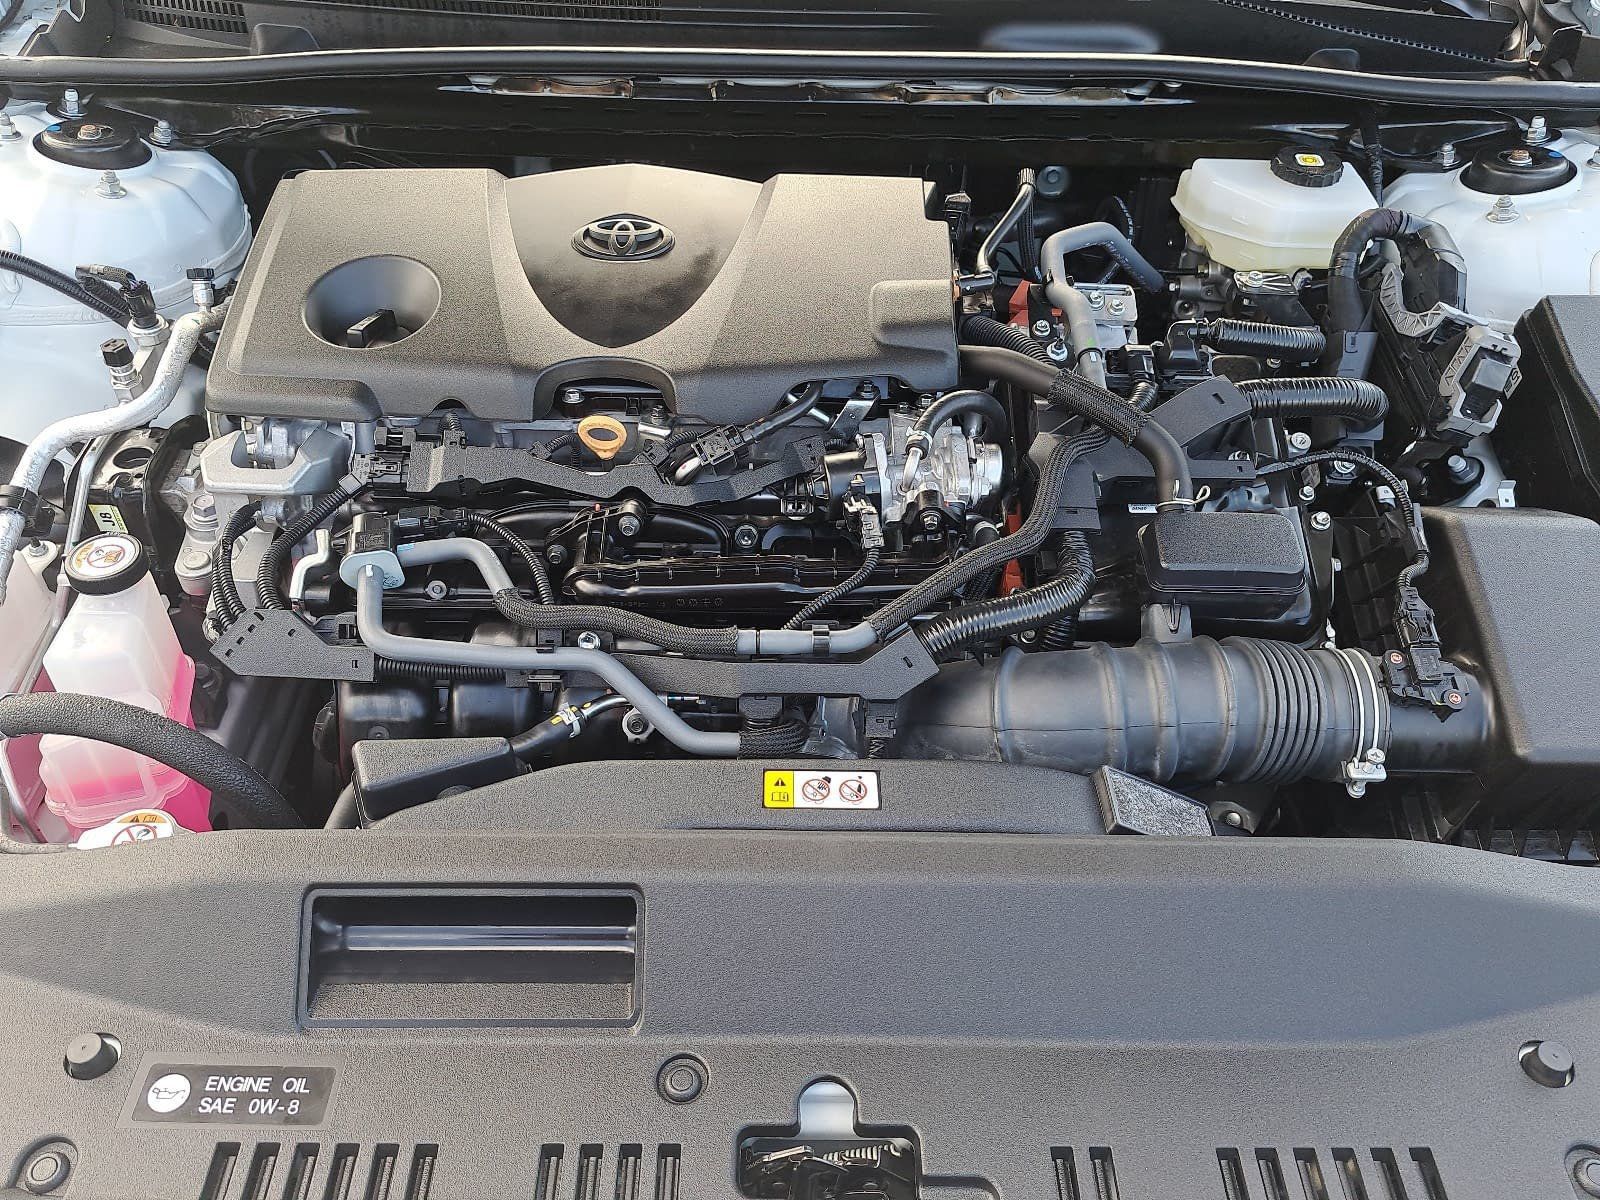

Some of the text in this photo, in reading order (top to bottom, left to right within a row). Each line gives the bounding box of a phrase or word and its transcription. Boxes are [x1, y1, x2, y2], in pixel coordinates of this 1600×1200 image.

[99, 512, 116, 527] J8
[205, 1076, 310, 1093] ENGINE OIL
[198, 1097, 300, 1115] SAE 0W-8
